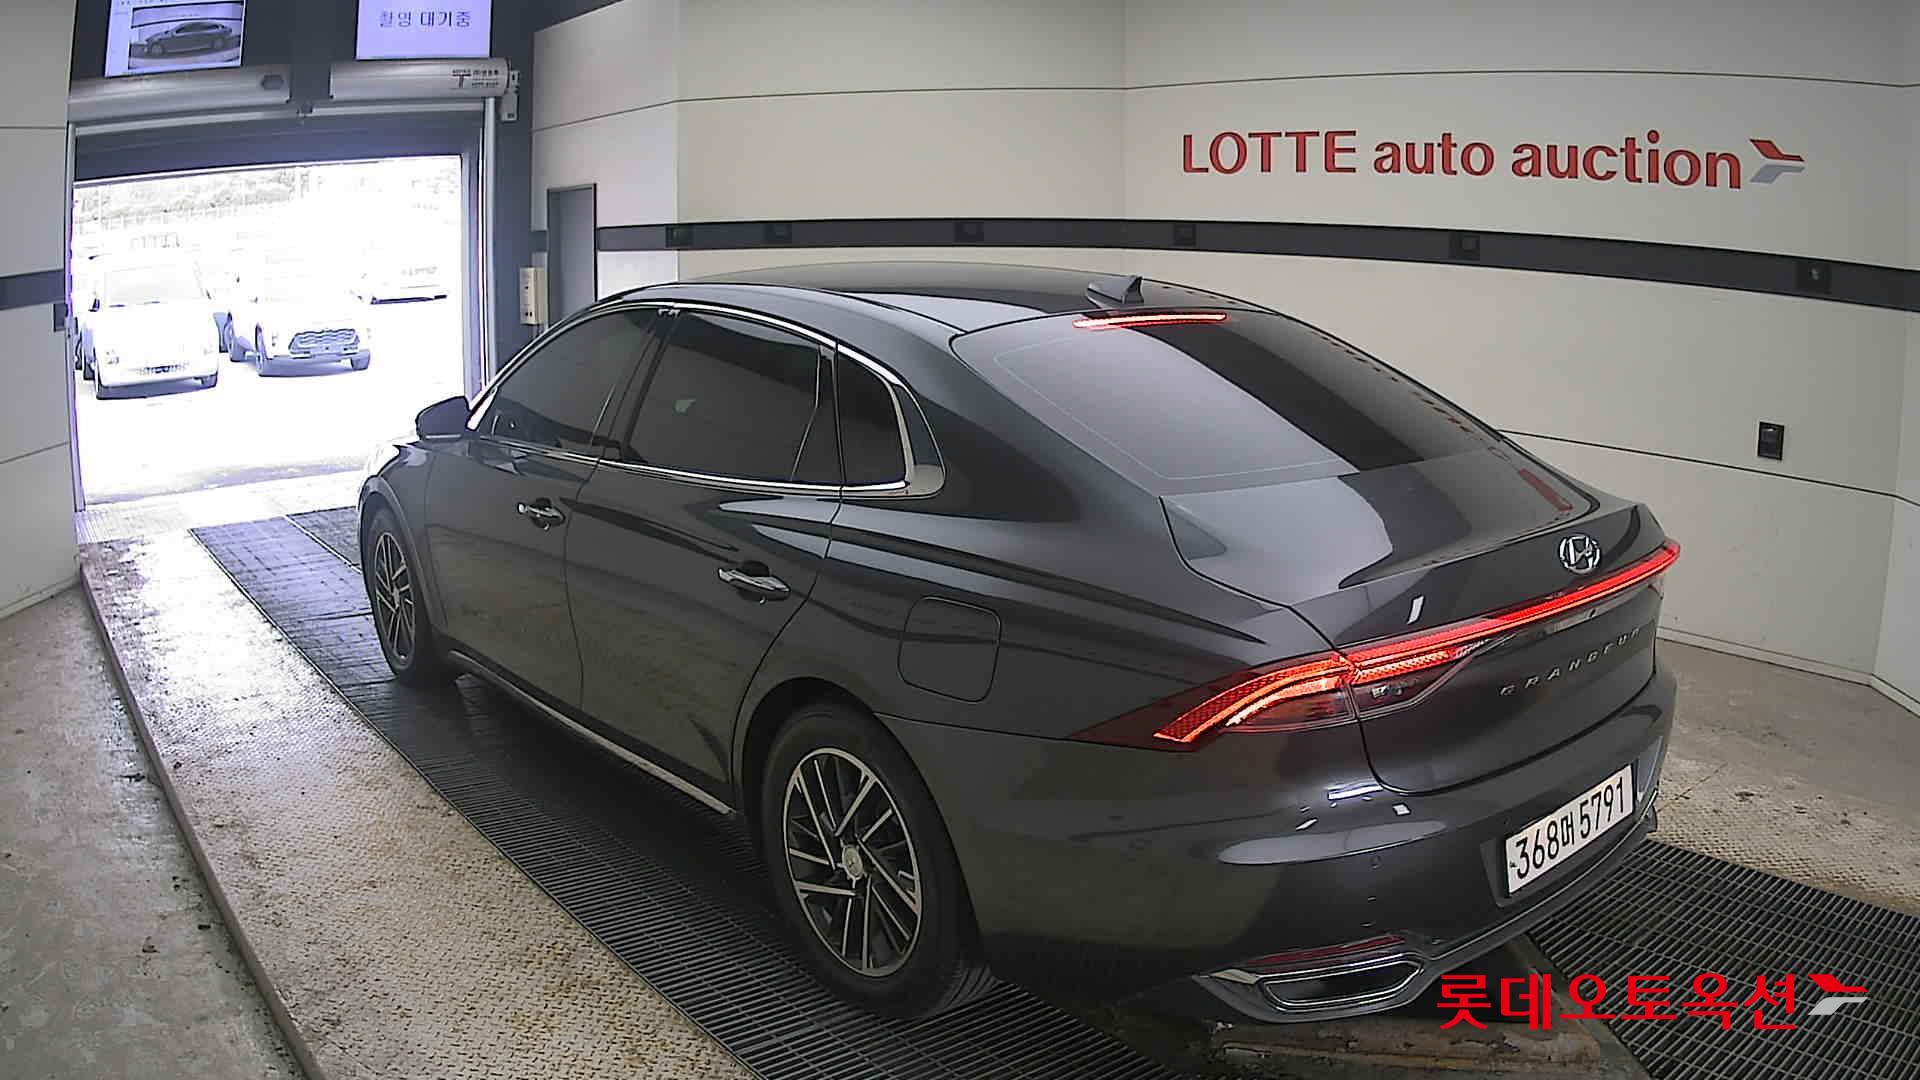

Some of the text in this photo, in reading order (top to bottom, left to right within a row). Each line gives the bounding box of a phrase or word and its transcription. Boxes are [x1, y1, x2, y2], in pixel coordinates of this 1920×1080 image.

[420, 11, 471, 28] 대기중
[1183, 130, 1742, 189] LOTTE auto auction
